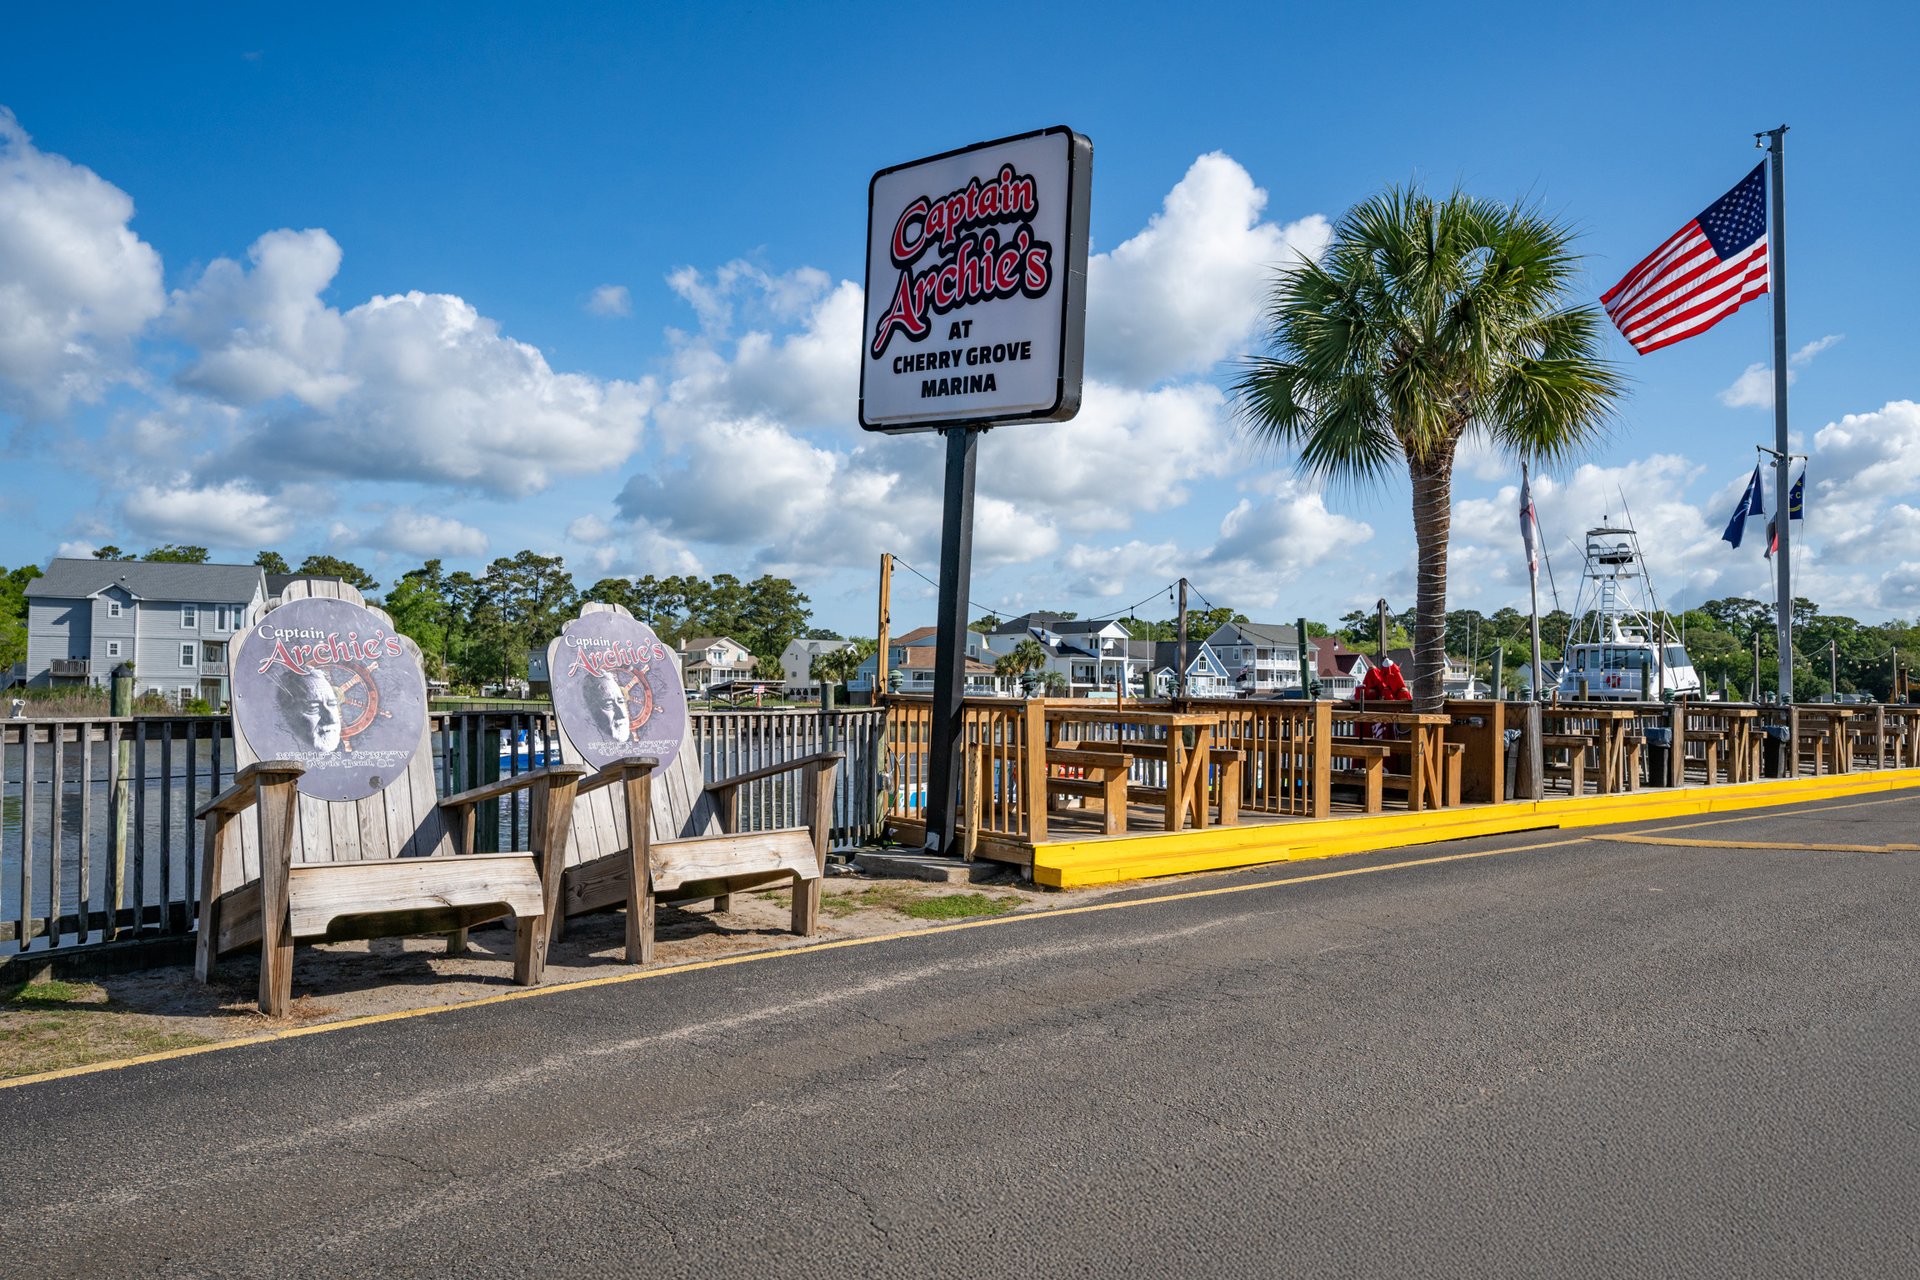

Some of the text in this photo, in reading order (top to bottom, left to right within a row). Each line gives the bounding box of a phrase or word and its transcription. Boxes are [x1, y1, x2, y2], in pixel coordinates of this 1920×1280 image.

[892, 165, 1036, 262] Captain
[873, 228, 1048, 352] Archie's
[948, 320, 972, 340] AT
[893, 341, 1031, 374] CHERRY GROVE
[921, 373, 996, 398] MARINA
[257, 625, 325, 642] Captain
[565, 635, 610, 650] Captain
[257, 629, 403, 675] Archie's
[567, 637, 665, 677] Archie's
